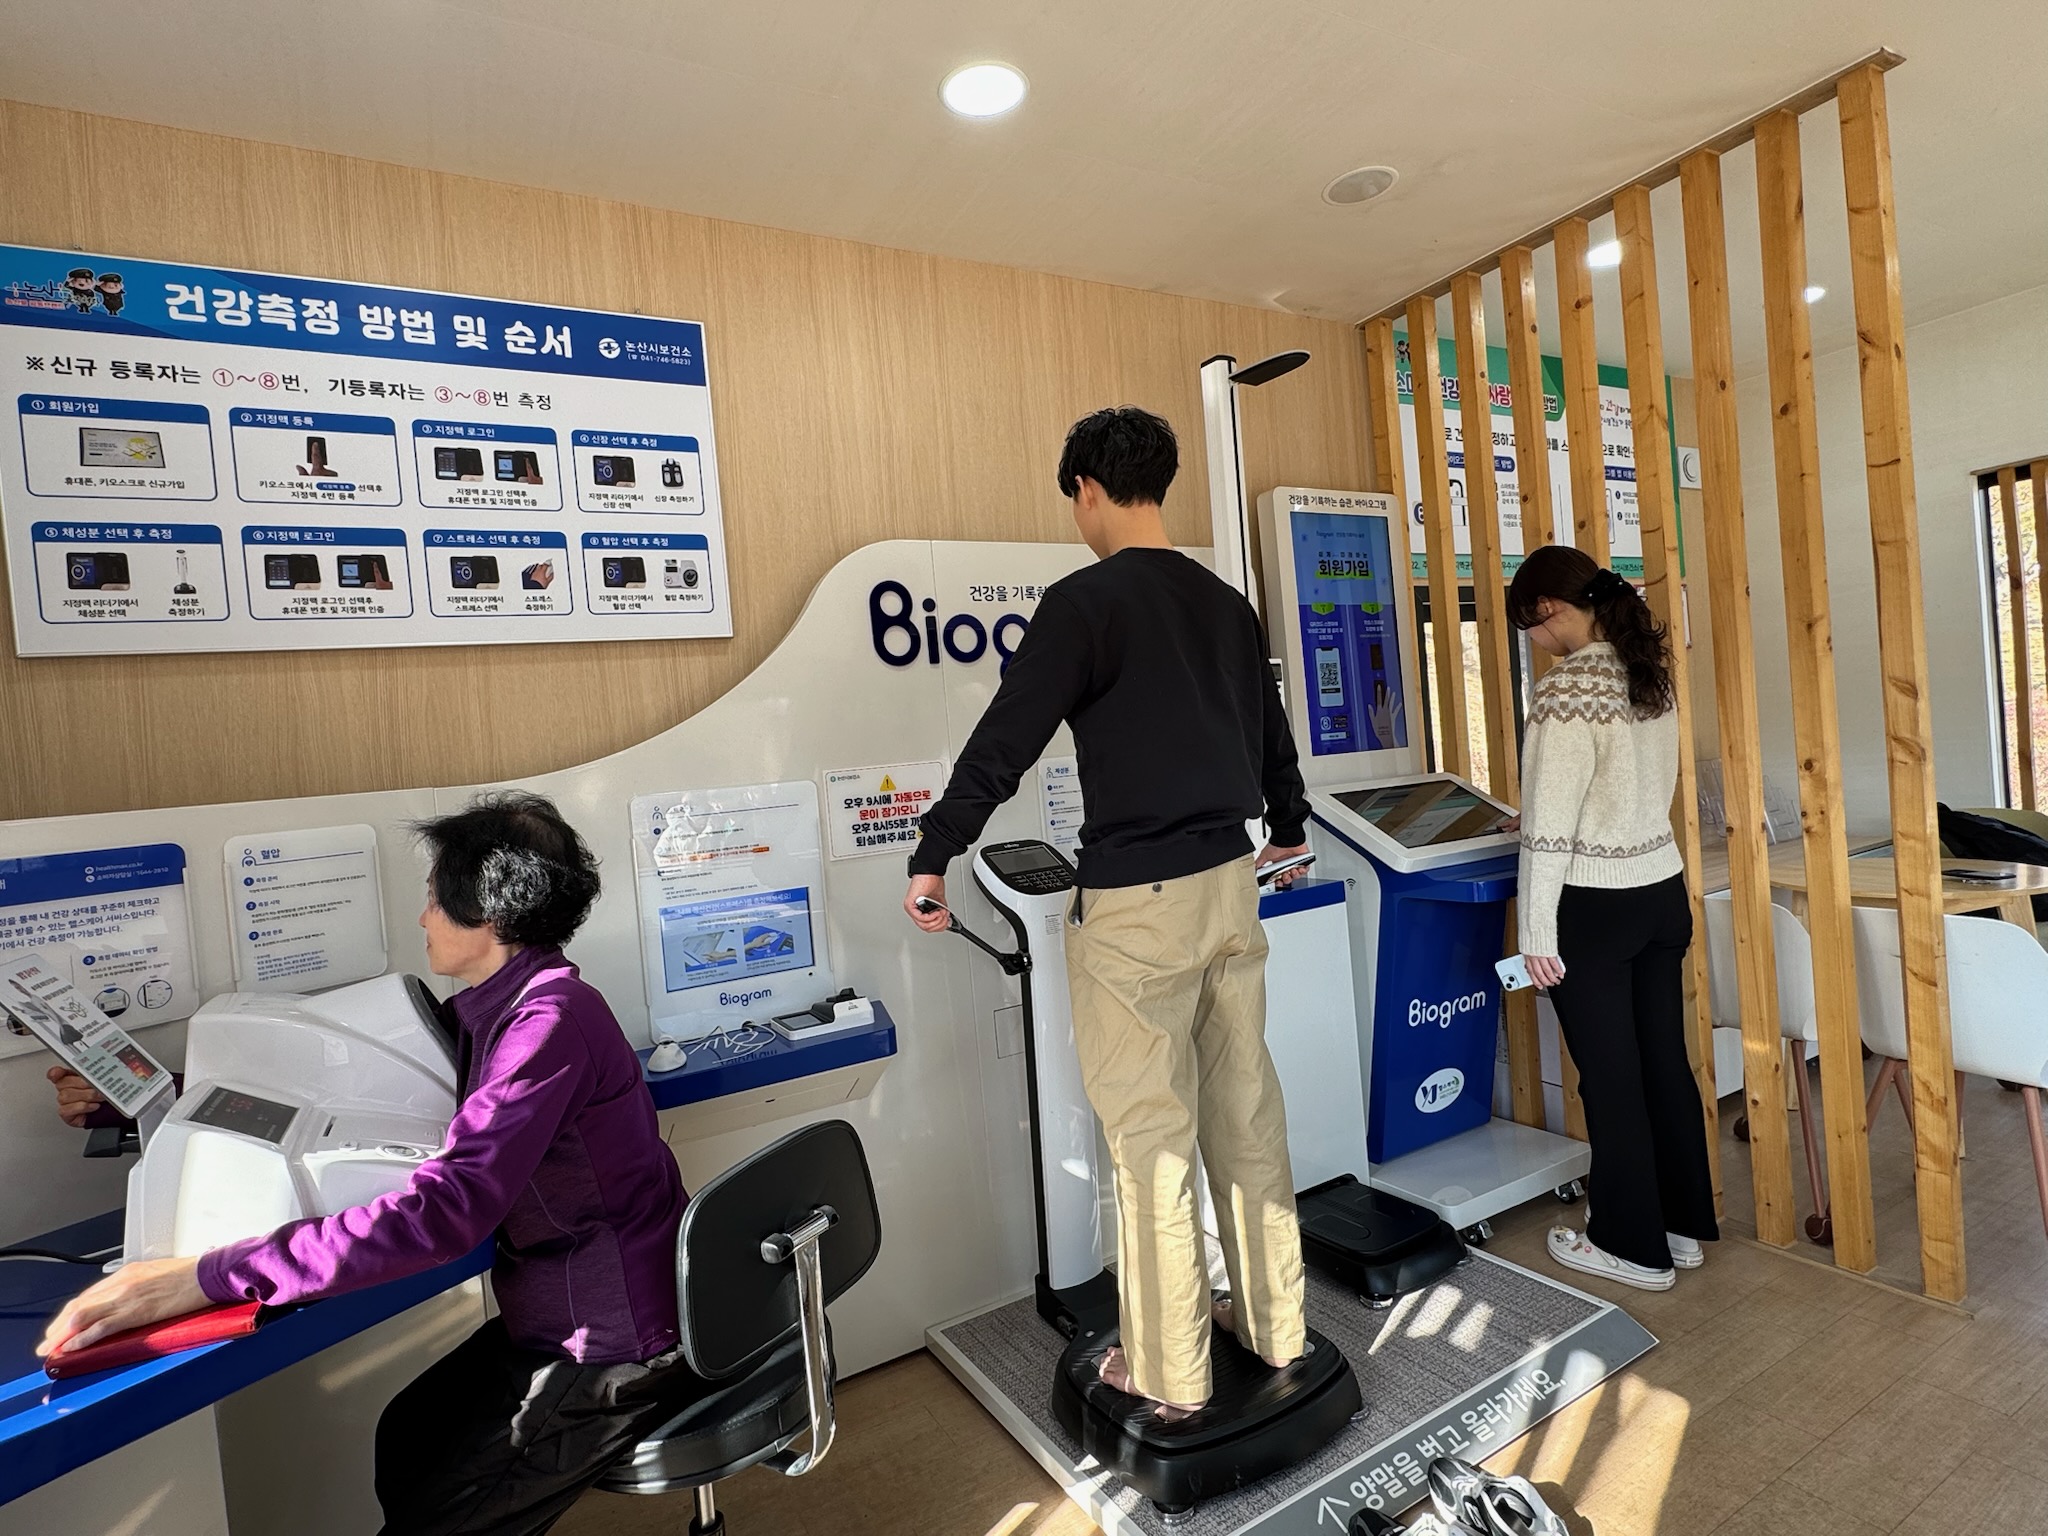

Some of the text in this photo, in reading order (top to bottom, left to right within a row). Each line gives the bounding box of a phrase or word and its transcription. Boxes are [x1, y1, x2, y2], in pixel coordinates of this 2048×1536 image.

[164, 283, 573, 359] 건강측정 방법 및 순서
[624, 340, 692, 358] 논산시보건소
[109, 360, 201, 384] 등록자는
[328, 378, 425, 401] 기등록자는
[517, 392, 552, 411] 측정
[49, 400, 99, 414] 회원가입
[256, 413, 289, 425] 지정맥
[292, 416, 314, 427] 등록
[435, 425, 465, 436] 지정맥
[467, 428, 495, 438] 로그인
[592, 435, 608, 445] 신장
[611, 436, 628, 446] 선택
[630, 437, 639, 446] 후
[641, 438, 658, 448] 측정
[64, 477, 185, 489] 휴대폰, 키오스크로 신규가입
[259, 480, 313, 490] 키오스크에서
[358, 484, 383, 493] 선택후
[291, 491, 355, 500] 지정맥 4번 등록
[456, 488, 479, 496] 지정맥
[473, 497, 487, 505] 번호
[490, 497, 497, 505] 및
[499, 498, 521, 506] 지정맥
[523, 499, 538, 507] 인증
[669, 495, 695, 503] 측정하기
[1288, 494, 1309, 506] 건강을
[1311, 495, 1337, 507] 기록하는
[1355, 499, 1387, 510] 바이오그램
[618, 502, 632, 510] 선택
[62, 527, 100, 539] 체성분
[104, 527, 129, 539] 선택
[133, 528, 144, 539] 후
[148, 529, 173, 539] 측정
[266, 531, 300, 542] 지정맥
[303, 532, 335, 542] 로그인
[446, 534, 485, 544] 스트레스
[488, 535, 507, 544] 선택
[510, 535, 519, 544] 후
[522, 535, 541, 545] 측정
[601, 537, 619, 546] 혈압
[621, 537, 639, 546] 선택
[641, 538, 650, 546] 후
[652, 538, 669, 547] 측정
[1318, 559, 1369, 577] 회원가입
[969, 585, 1008, 602] 건강을
[62, 598, 139, 607] 지정맥 리더기에서
[172, 598, 200, 606] 체성분
[292, 596, 373, 605] 지정맥 로그인 선택후
[78, 609, 127, 618] 체성분 선택
[168, 608, 205, 616] 측정하기
[281, 605, 384, 615] 휴대폰 번호 및 지정맥 인증
[484, 604, 498, 612] 선택
[844, 790, 931, 809] 오후 9시에 자동으로
[859, 809, 879, 820] 문이
[852, 818, 909, 835] 오후 8시55분
[856, 830, 916, 847] 퇴실해주세요
[260, 848, 280, 860] 혈압
[19, 914, 38, 923] 통해
[40, 913, 49, 921] 내
[52, 909, 69, 919] 건강
[72, 906, 98, 917] 상태를
[100, 903, 126, 912] 꾸준히
[127, 897, 160, 908] 체크하고
[15, 927, 34, 936] 받을
[36, 925, 46, 934] 수
[50, 922, 66, 931] 있는
[68, 917, 103, 929] 헬스케어
[105, 909, 158, 923] 서비스입니다.
[27, 936, 46, 946] 건강
[49, 932, 75, 943] 측정이
[77, 925, 123, 937] 가능합니다.
[719, 988, 772, 1007] Biogram
[1408, 991, 1486, 1029] Biogram
[1350, 1452, 1428, 1511] 양말을
[1461, 1369, 1567, 1443] 올라가세요.
